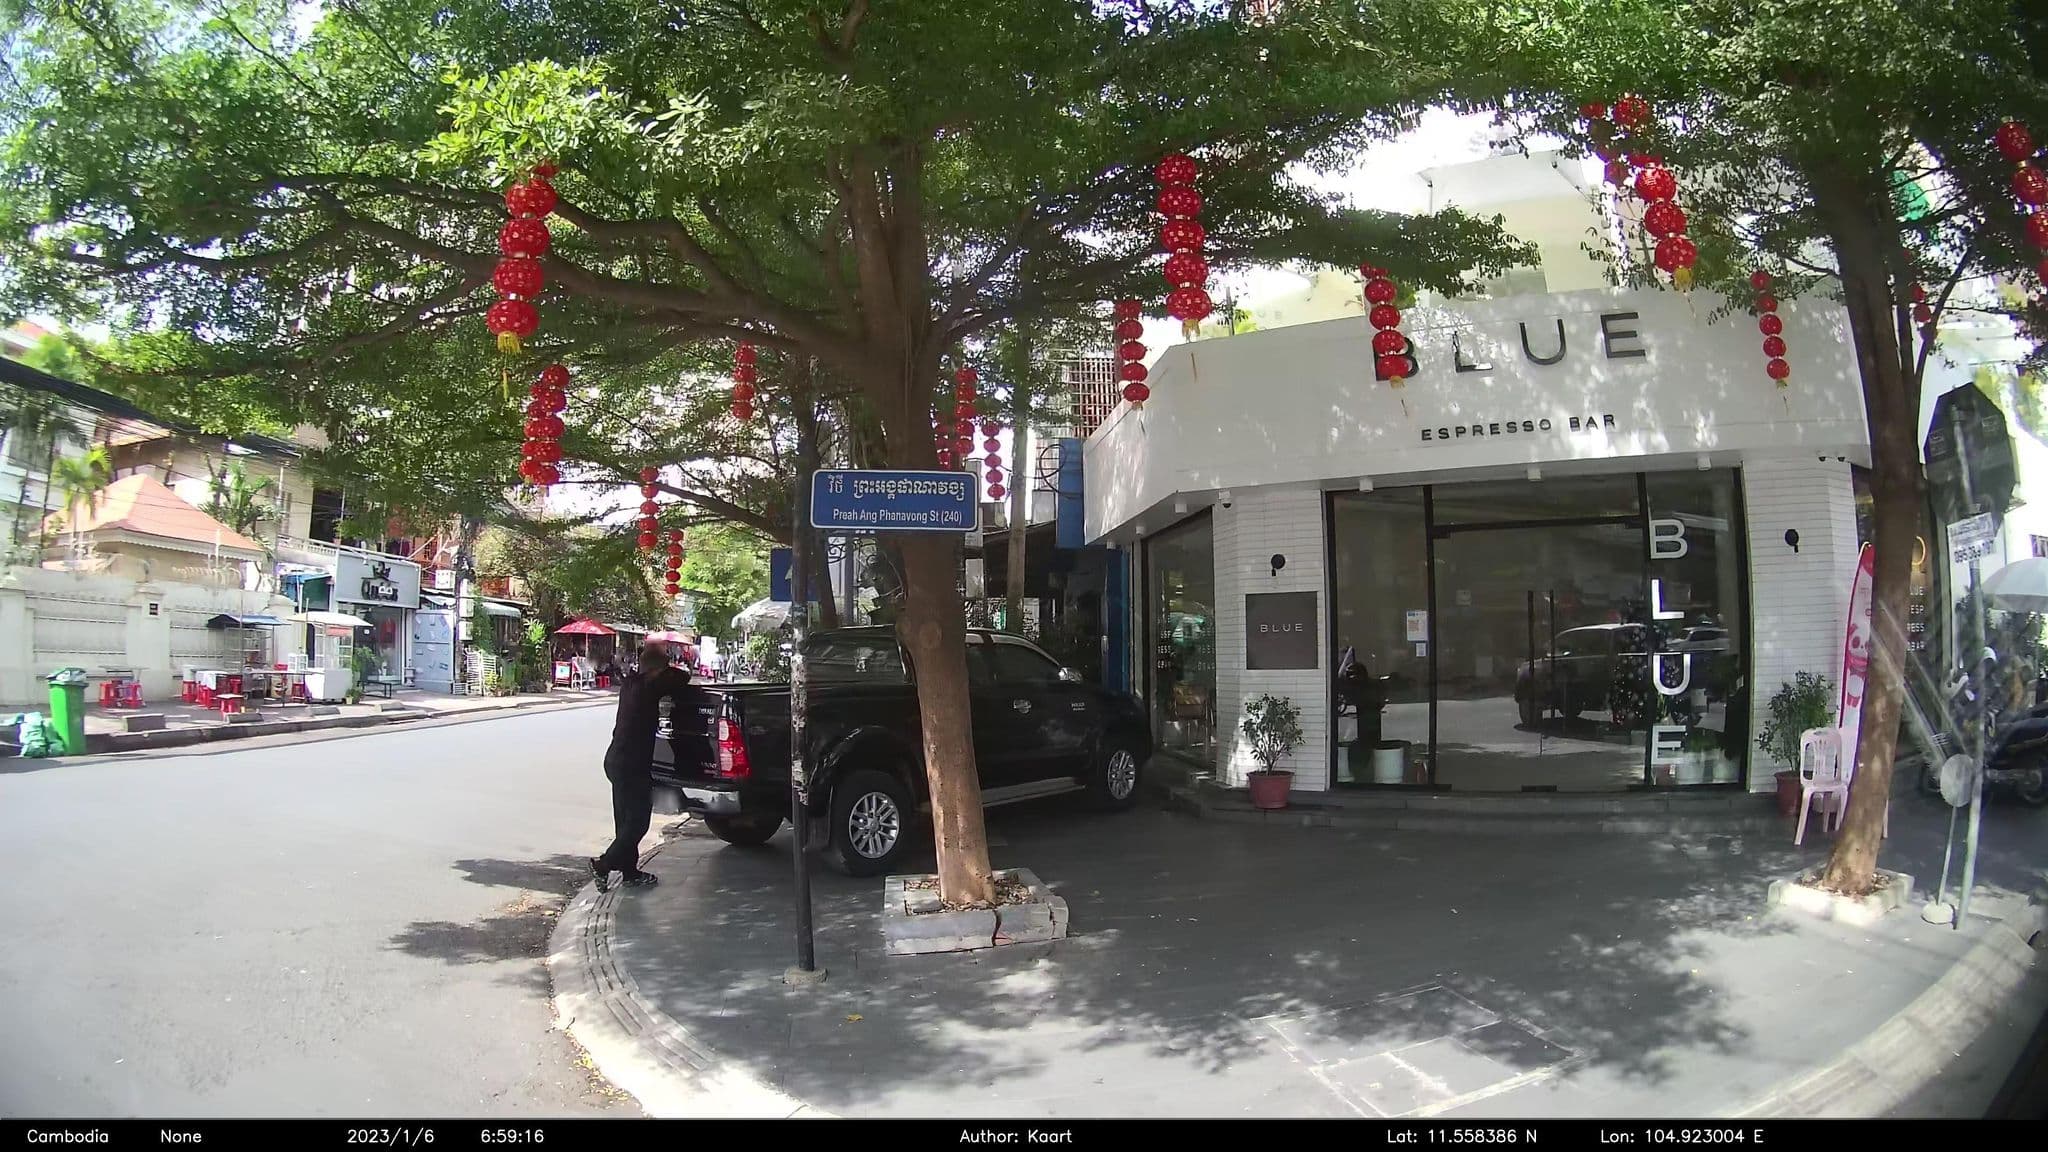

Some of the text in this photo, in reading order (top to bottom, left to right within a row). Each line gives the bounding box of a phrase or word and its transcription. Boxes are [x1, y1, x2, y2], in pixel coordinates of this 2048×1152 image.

[1421, 414, 1616, 441] ESPRESSO BAR
[833, 508, 962, 525] Preah Ang Phanavong St (240)
[1260, 623, 1304, 633] BLUE
[1650, 518, 1691, 767] BLUE
